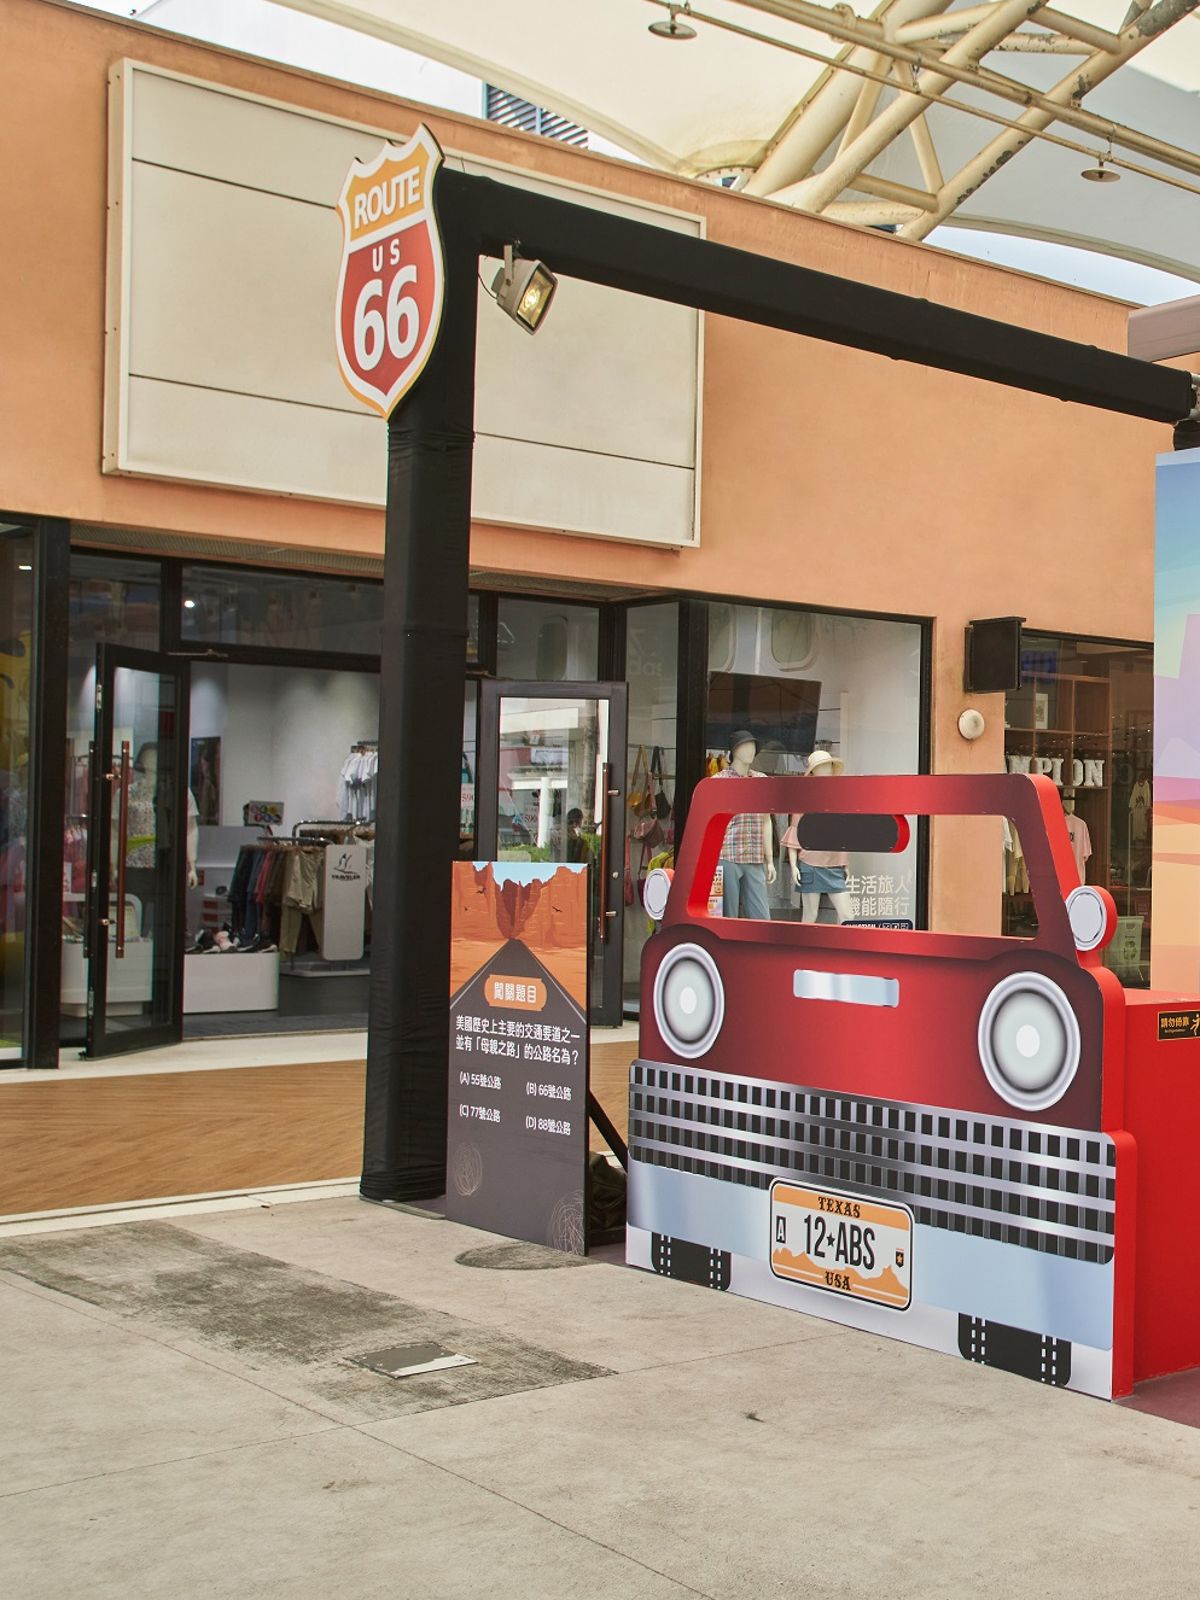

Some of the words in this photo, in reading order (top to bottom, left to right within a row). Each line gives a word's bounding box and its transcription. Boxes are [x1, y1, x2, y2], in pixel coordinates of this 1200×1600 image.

[354, 166, 420, 230] ROUTE
[372, 238, 400, 273] US
[354, 264, 420, 372] 66
[1003, 755, 1105, 787] MPION
[845, 874, 910, 895] 生活旅人
[494, 981, 537, 1004] 闖關題目
[456, 1015, 581, 1044] 美國歷史上主要的交通要道之一
[817, 1196, 861, 1219] TEXAS
[824, 1271, 852, 1291] USA
